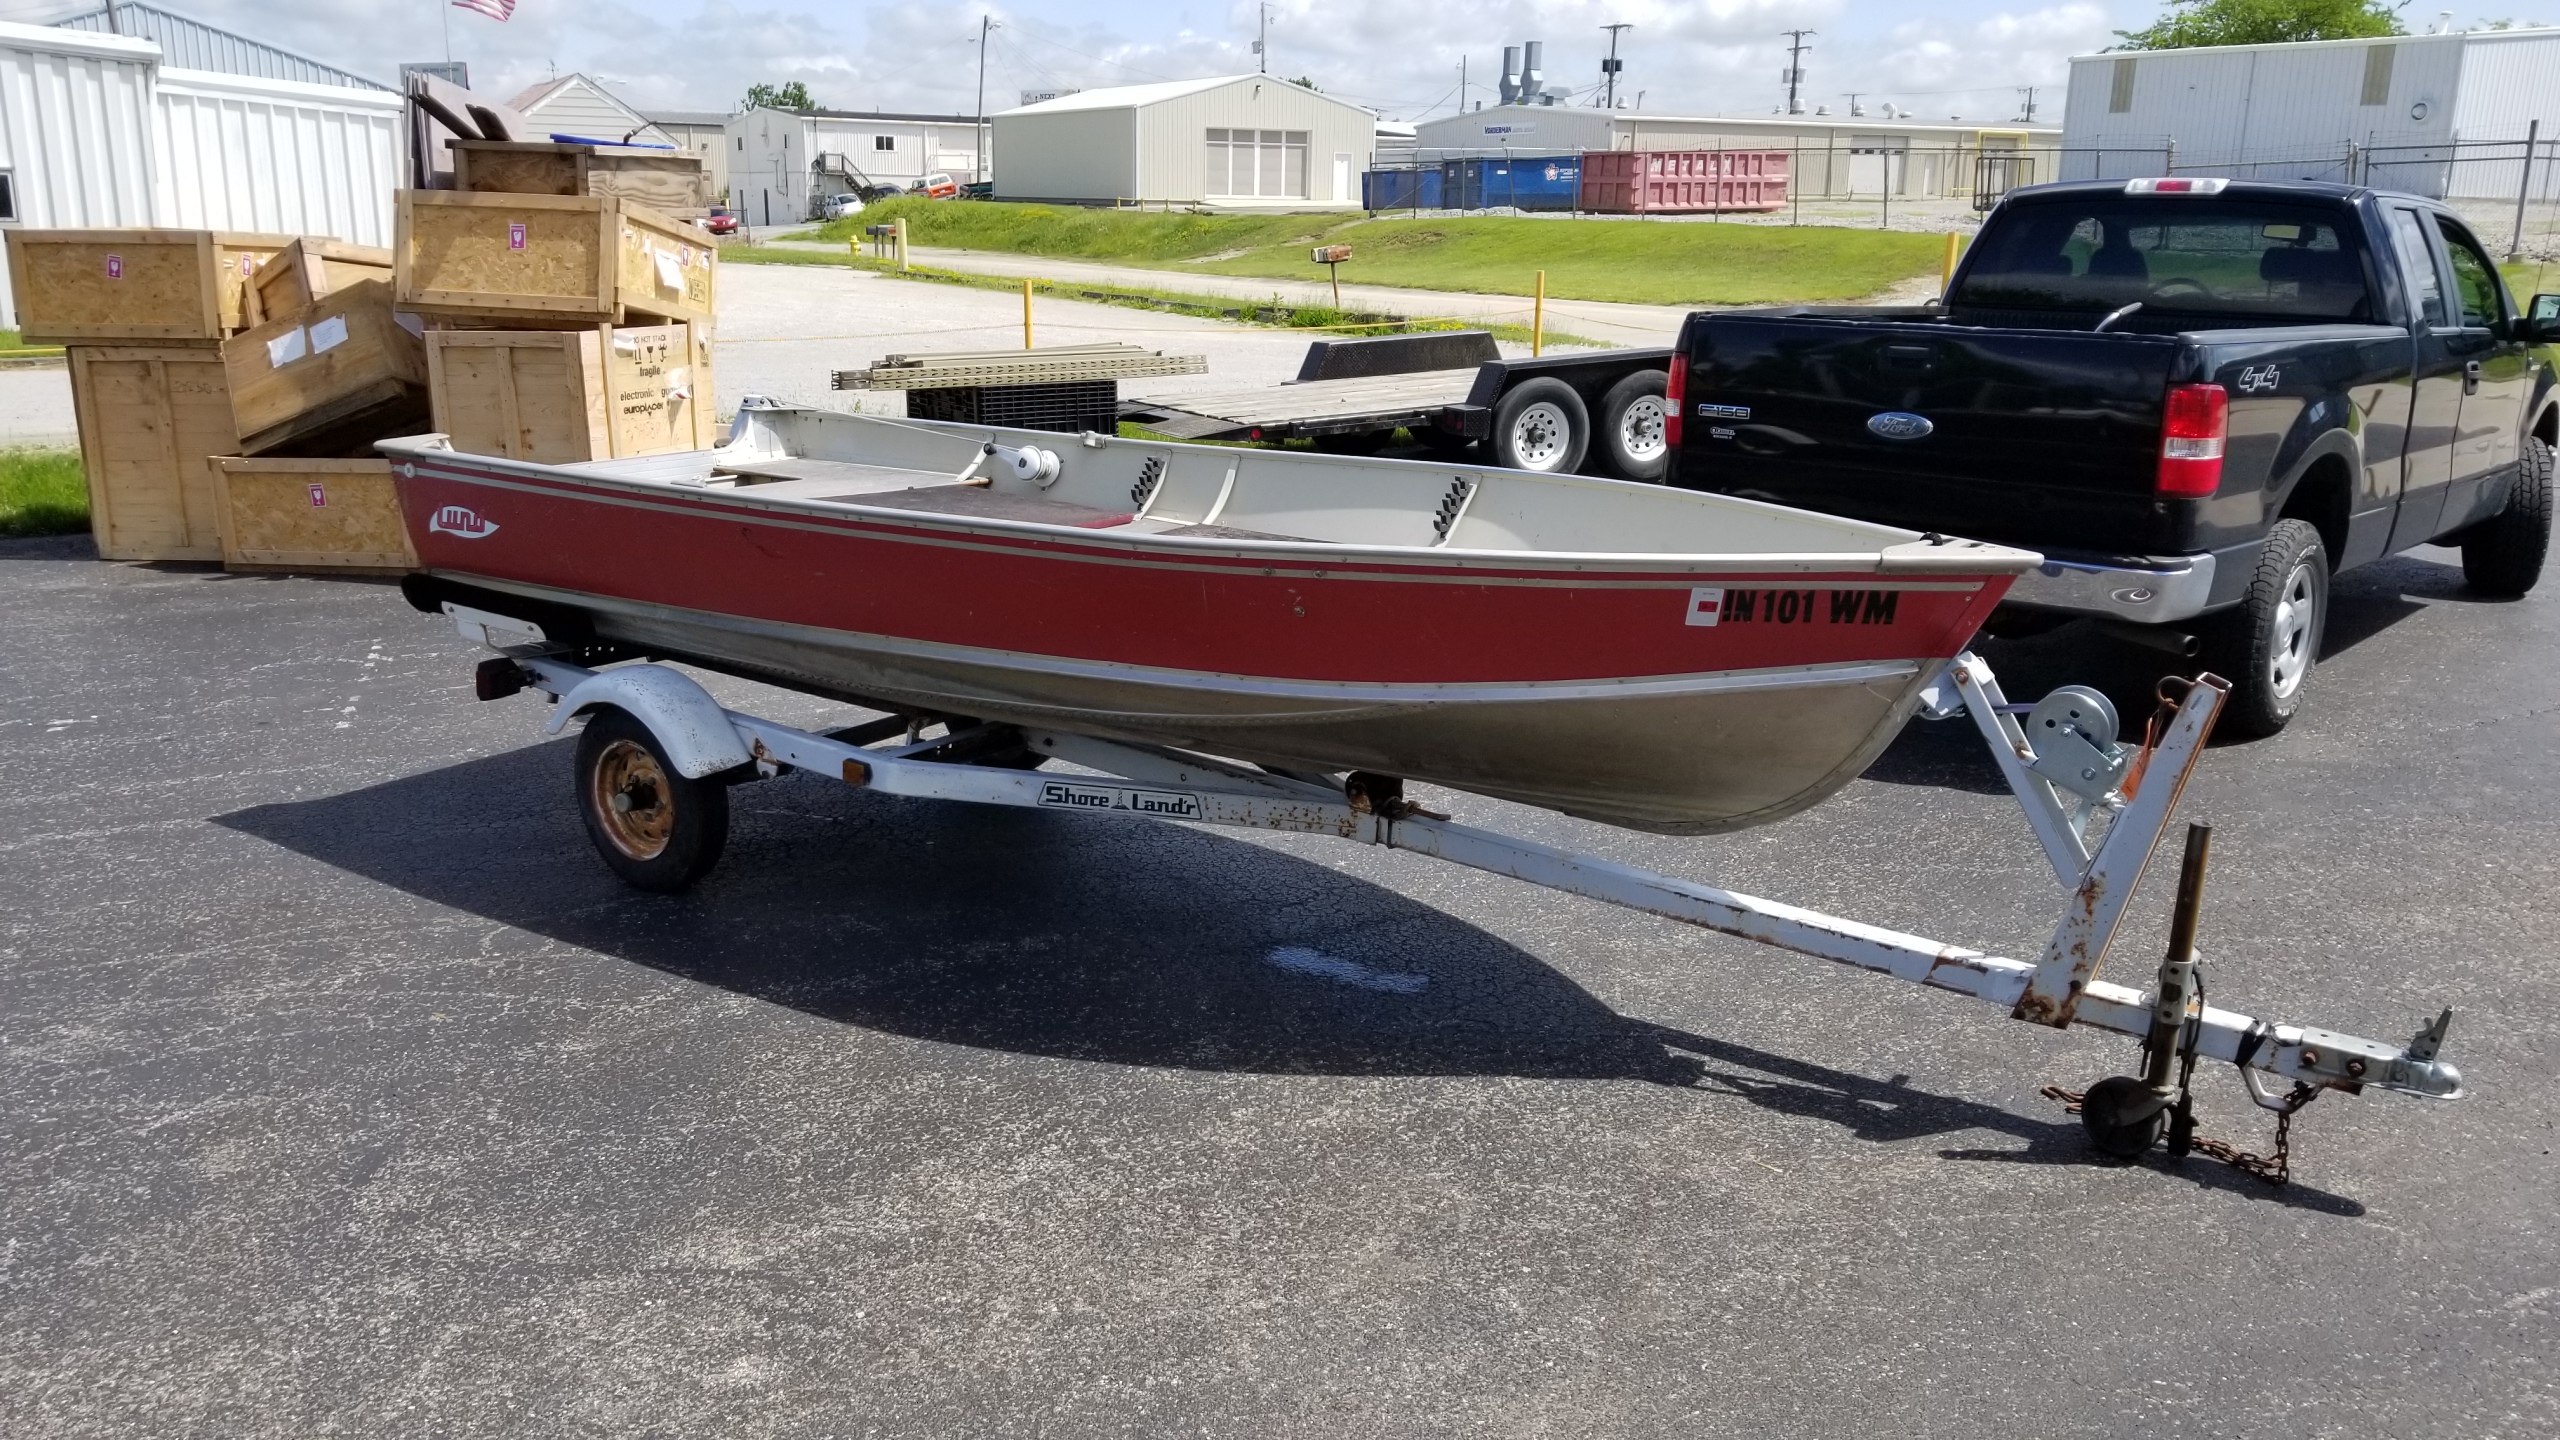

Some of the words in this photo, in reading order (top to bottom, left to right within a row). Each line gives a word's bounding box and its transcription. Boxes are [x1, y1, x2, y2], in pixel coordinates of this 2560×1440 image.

[641, 335, 651, 343] NOT
[640, 365, 661, 378] fragile
[620, 388, 655, 401] electronic
[1722, 589, 1757, 622] IN
[1763, 590, 1816, 624] 101
[1830, 590, 1900, 625] WM
[1046, 786, 1109, 808] Shore
[1132, 793, 1196, 815] Land'r
